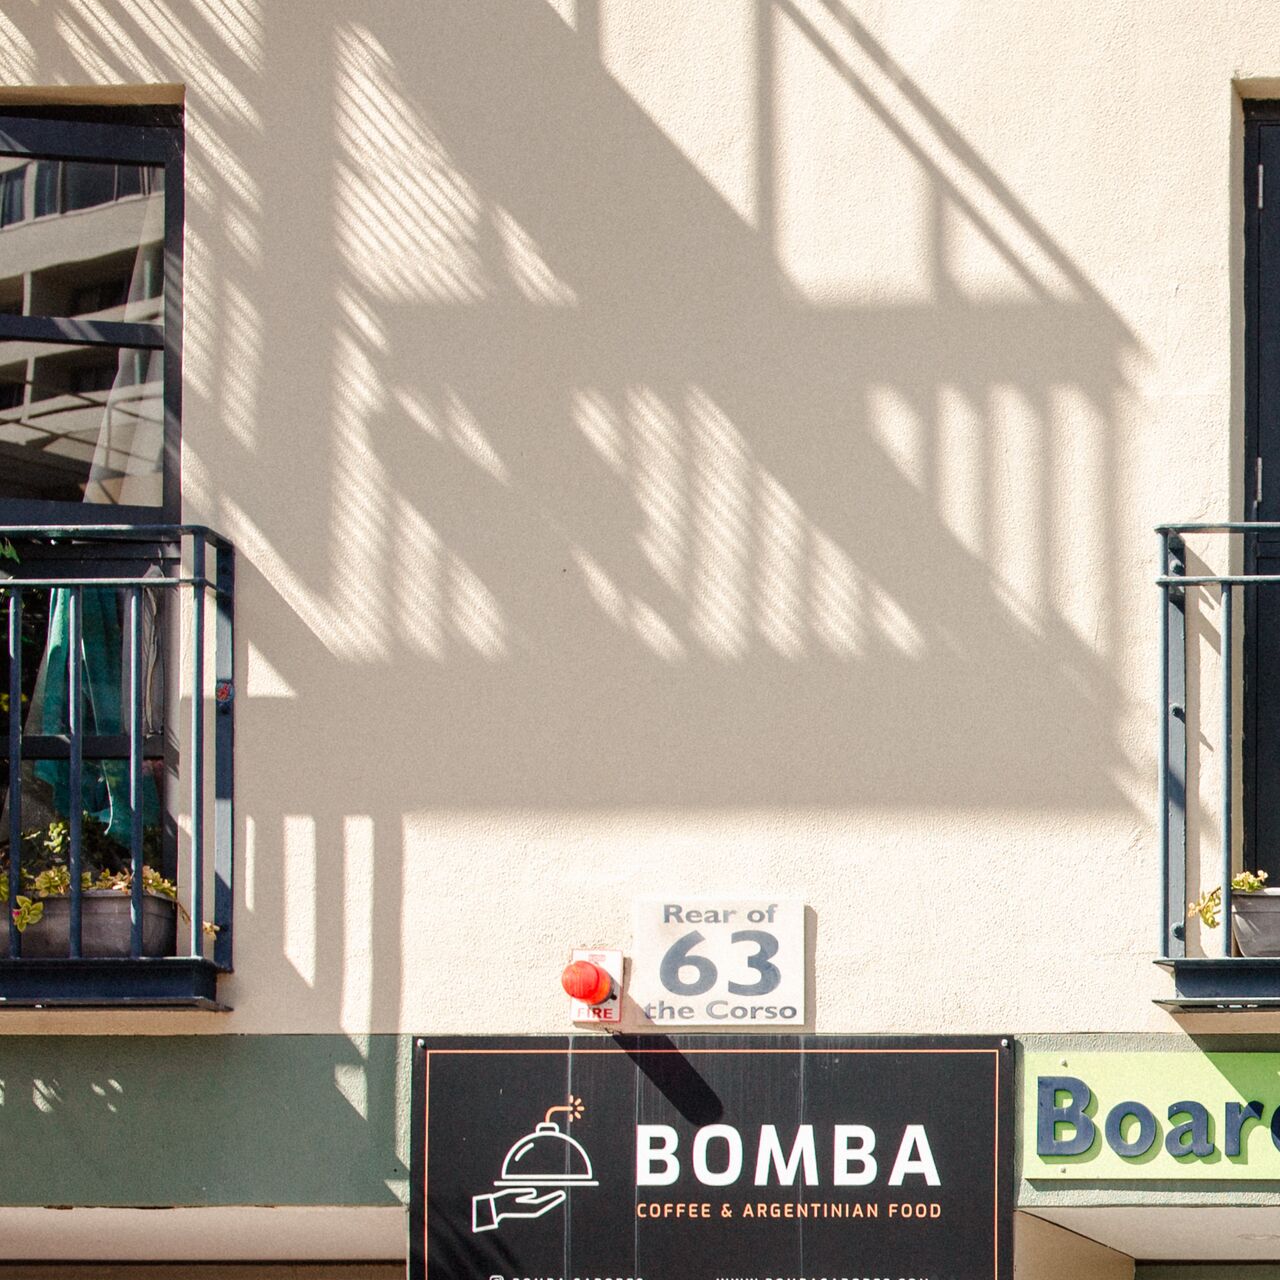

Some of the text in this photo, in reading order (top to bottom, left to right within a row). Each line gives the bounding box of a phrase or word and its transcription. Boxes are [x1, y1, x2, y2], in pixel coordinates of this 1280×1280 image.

[663, 903, 778, 924] Rear of
[659, 929, 782, 997] 63
[577, 1007, 613, 1019] FIRE
[645, 1000, 797, 1020] the Corso
[635, 1123, 942, 1187] BOMBA
[636, 1203, 942, 1219] COFFEE & ARGENTINIAN FOOD
